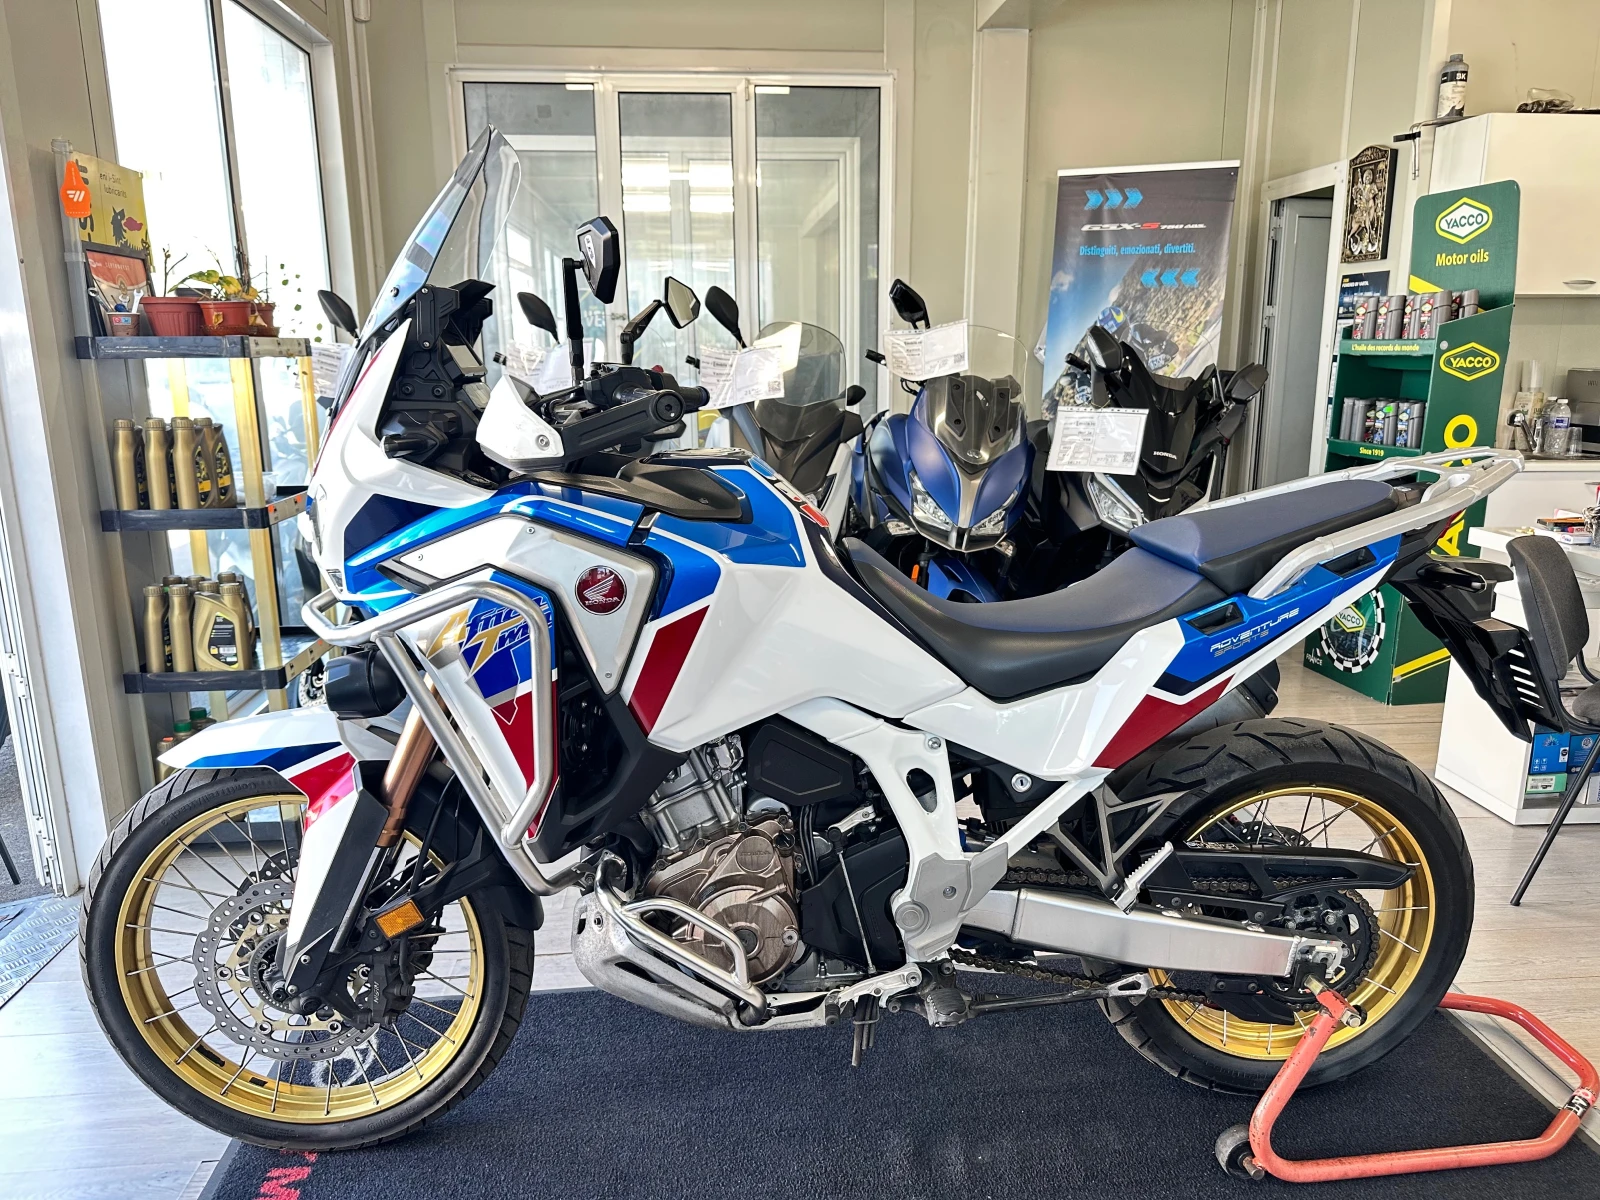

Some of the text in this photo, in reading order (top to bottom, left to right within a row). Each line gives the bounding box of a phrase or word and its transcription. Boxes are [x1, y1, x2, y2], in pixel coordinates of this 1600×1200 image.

[103, 184, 127, 198] lubricants
[1445, 213, 1484, 229] YACCO
[1079, 242, 1196, 257] Distinguiti, emozionati, divertiti.
[1435, 248, 1489, 267] Motor oils
[1352, 343, 1419, 352] L'huile des records du monde
[1450, 356, 1492, 368] YACCO
[1153, 451, 1178, 460] HONDA
[1359, 447, 1384, 457] Since 1919
[585, 596, 621, 606] HONDA
[1210, 608, 1300, 653] ADVENTURE
[1306, 648, 1323, 666] FRANCE
